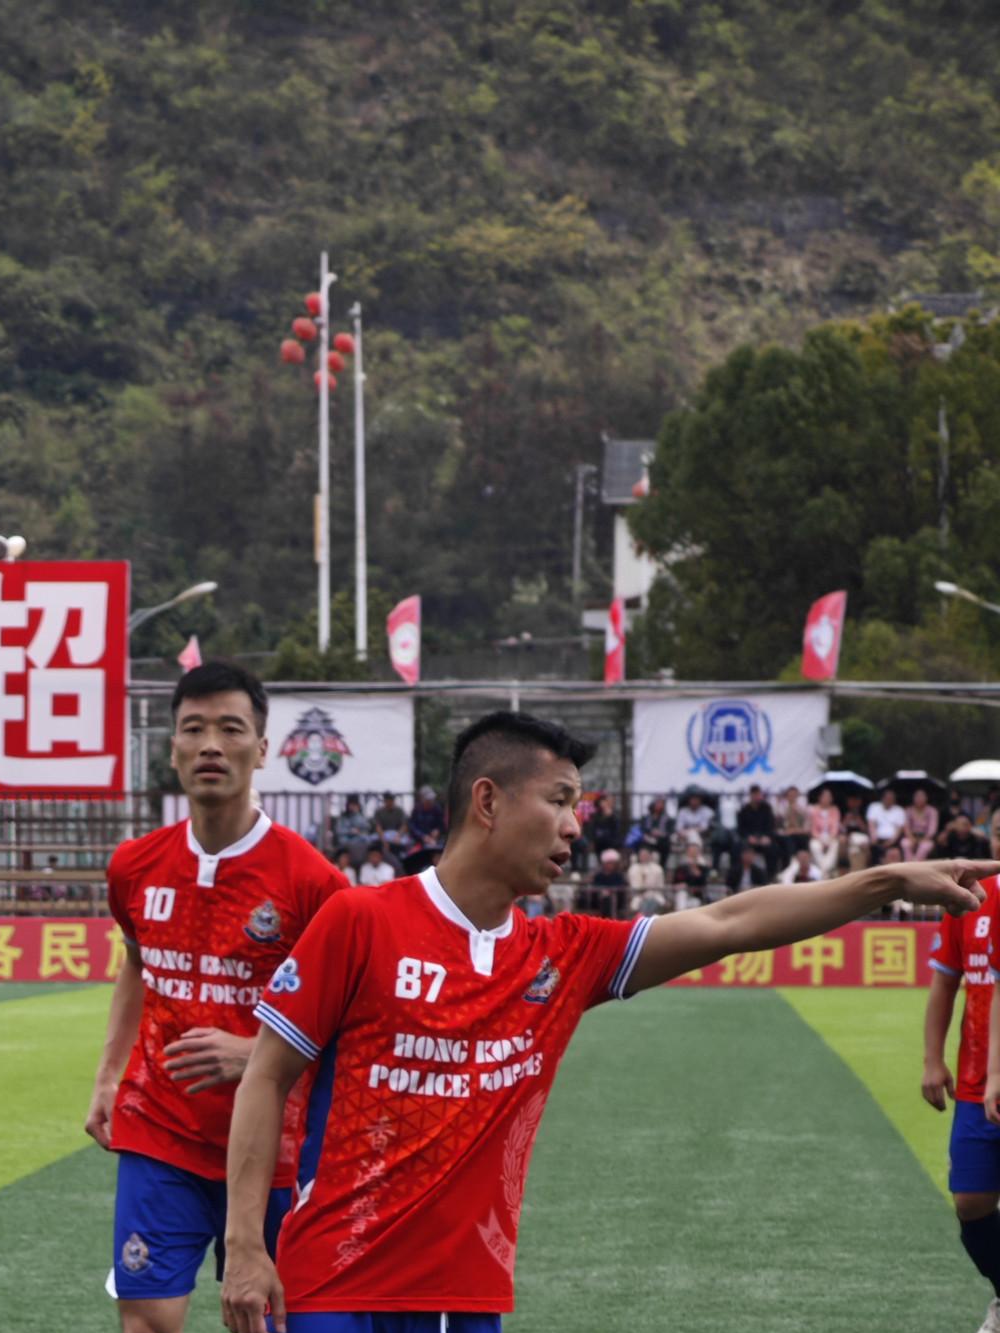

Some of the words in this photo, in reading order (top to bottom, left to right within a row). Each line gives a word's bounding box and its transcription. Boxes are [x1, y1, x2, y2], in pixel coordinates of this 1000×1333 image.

[144, 886, 176, 921] 10
[395, 957, 447, 1003] 87
[393, 1032, 469, 1064] HONG
[368, 1063, 470, 1098] POLICE
